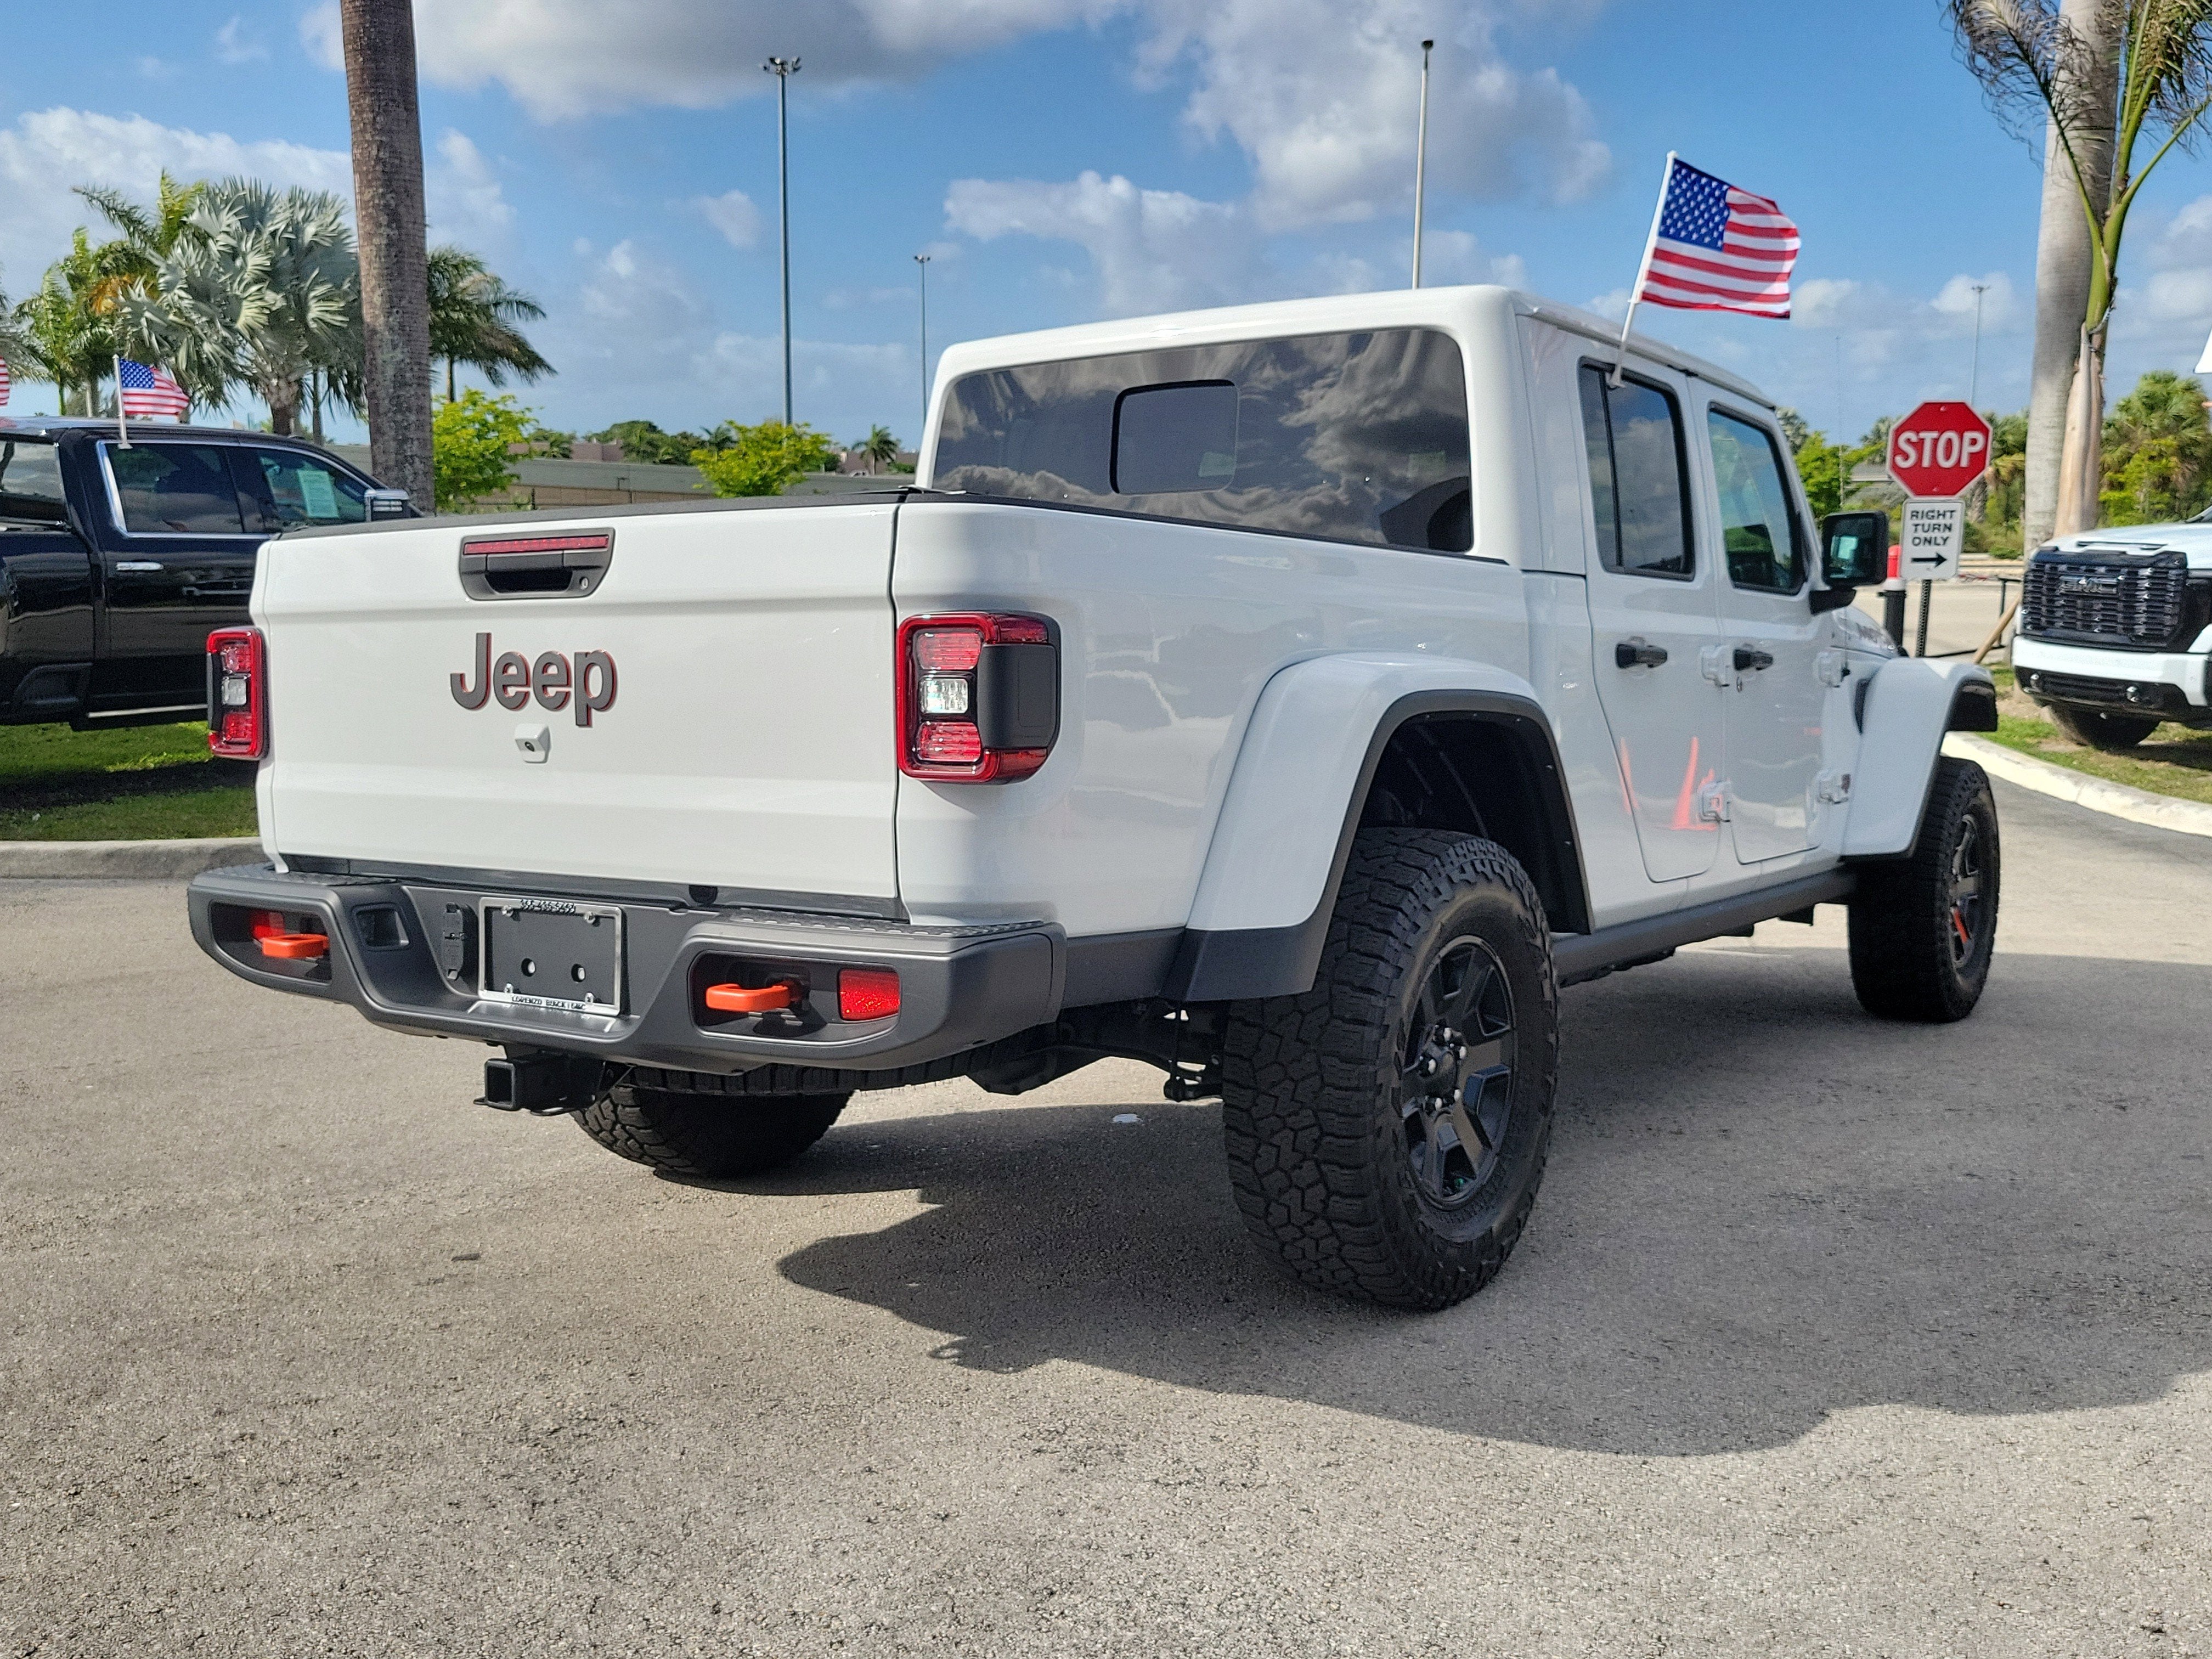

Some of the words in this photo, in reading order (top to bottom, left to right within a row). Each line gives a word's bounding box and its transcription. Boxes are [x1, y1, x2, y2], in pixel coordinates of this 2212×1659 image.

[1894, 431, 1985, 468] STOP
[1911, 510, 1956, 520] RIGHT
[1911, 522, 1953, 533] TURN
[1911, 535, 1950, 546] ONLY
[450, 632, 618, 727] Jeep
